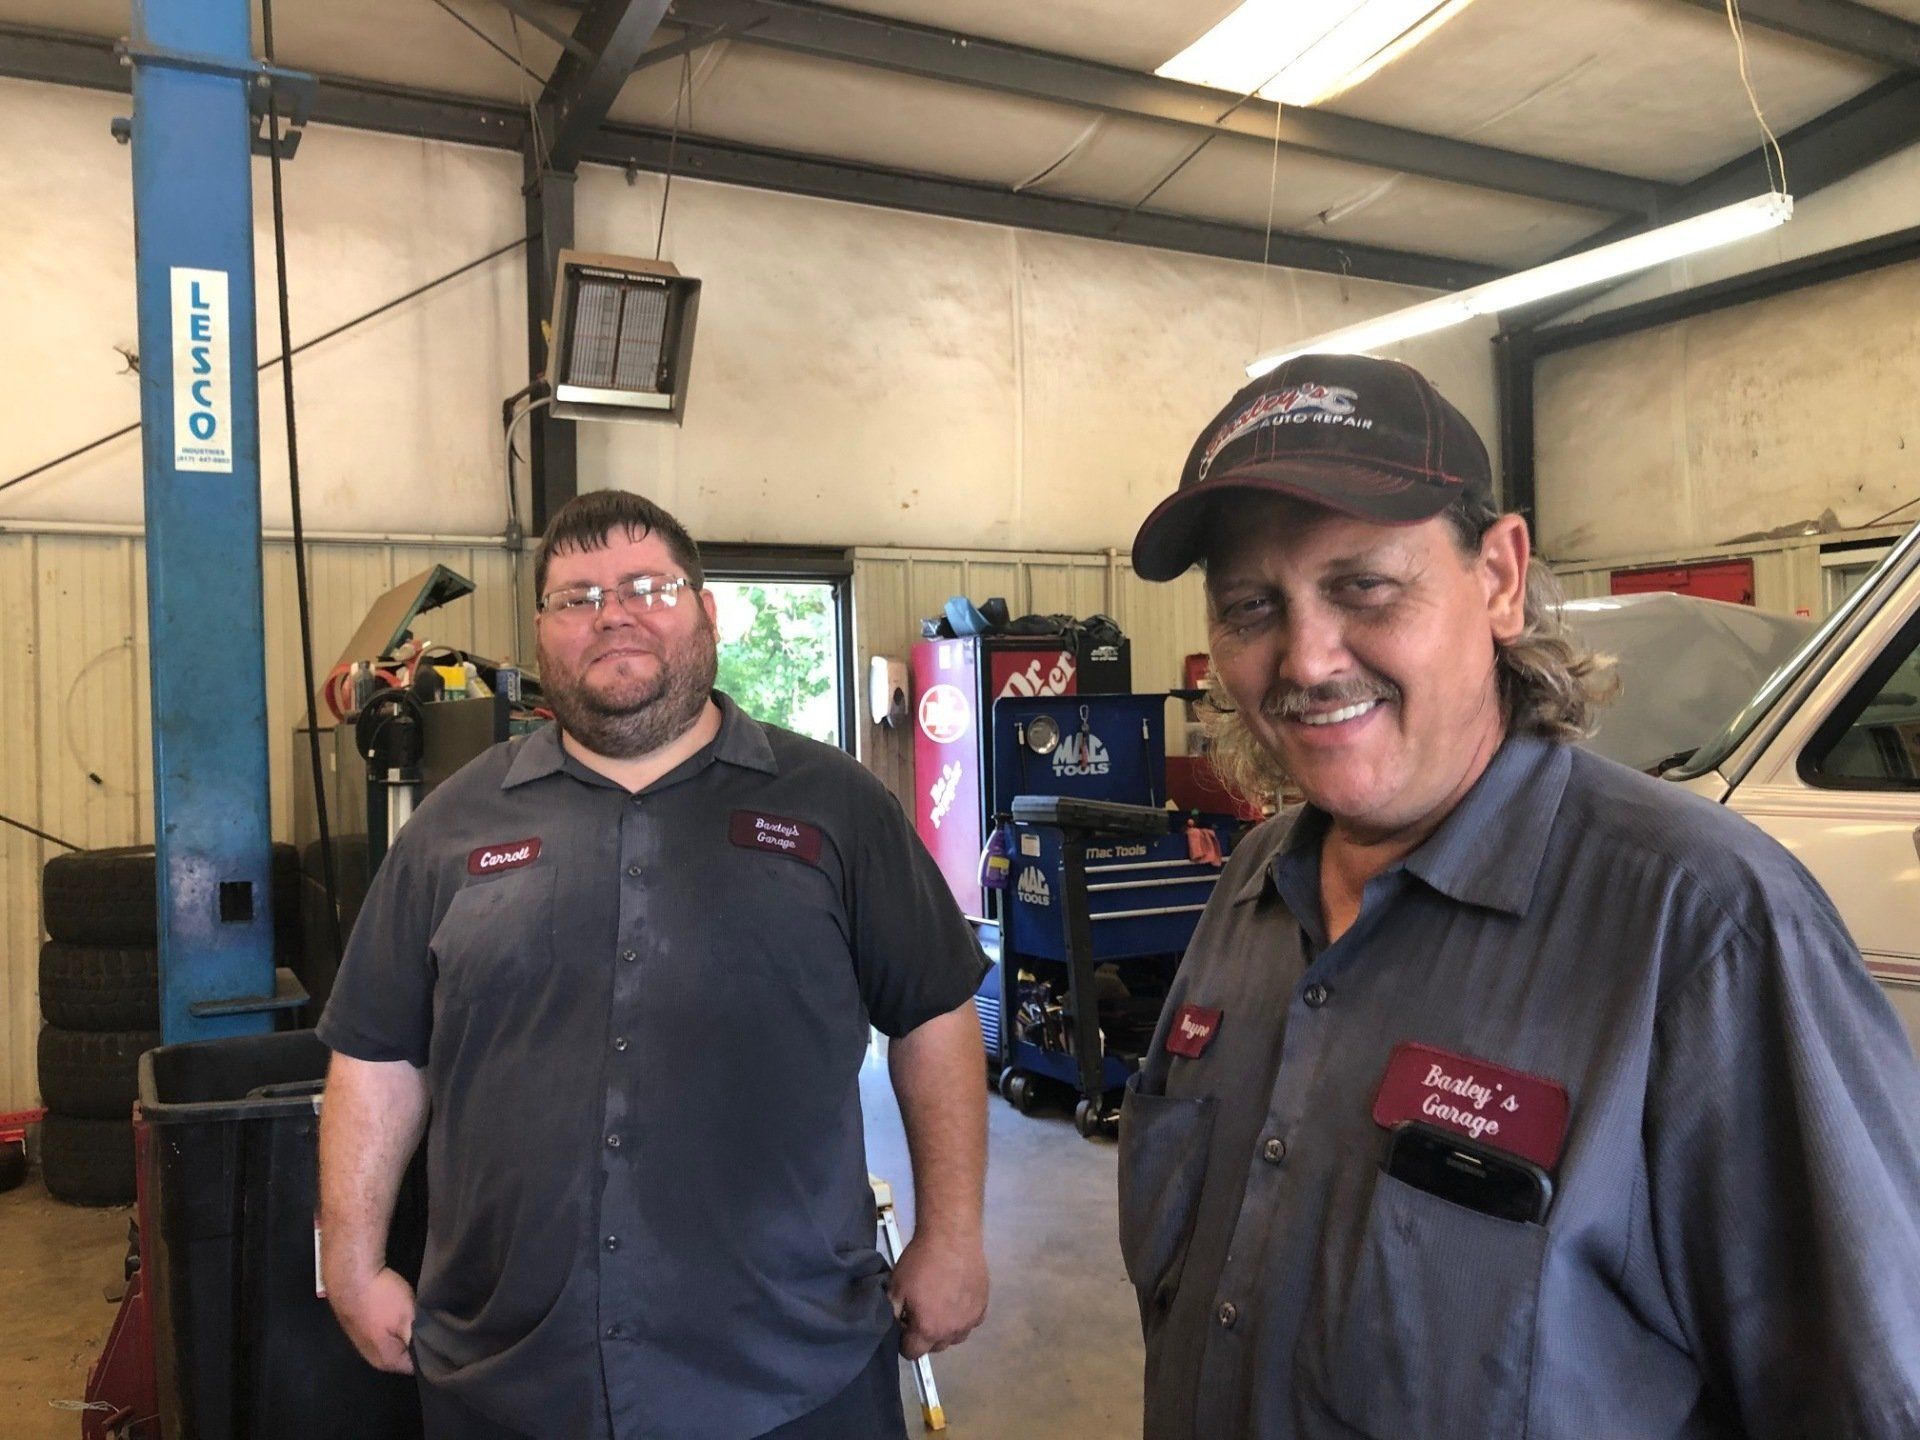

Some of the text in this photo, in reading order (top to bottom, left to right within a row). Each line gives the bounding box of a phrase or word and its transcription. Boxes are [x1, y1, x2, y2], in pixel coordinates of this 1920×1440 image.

[189, 281, 216, 440] LESCO
[1260, 413, 1373, 430] AUTO REPAIR
[1052, 732, 1110, 765] MAC
[1052, 762, 1110, 777] TOOLS
[755, 817, 799, 837] Baxley's
[757, 831, 796, 850] Garage
[480, 846, 530, 868] Carroll
[1086, 844, 1146, 860] Mac Tools
[1018, 865, 1050, 895] MAC
[1018, 891, 1050, 906] TOOLS
[1421, 1064, 1519, 1112] Baxley's
[1422, 1093, 1500, 1138] Garage
